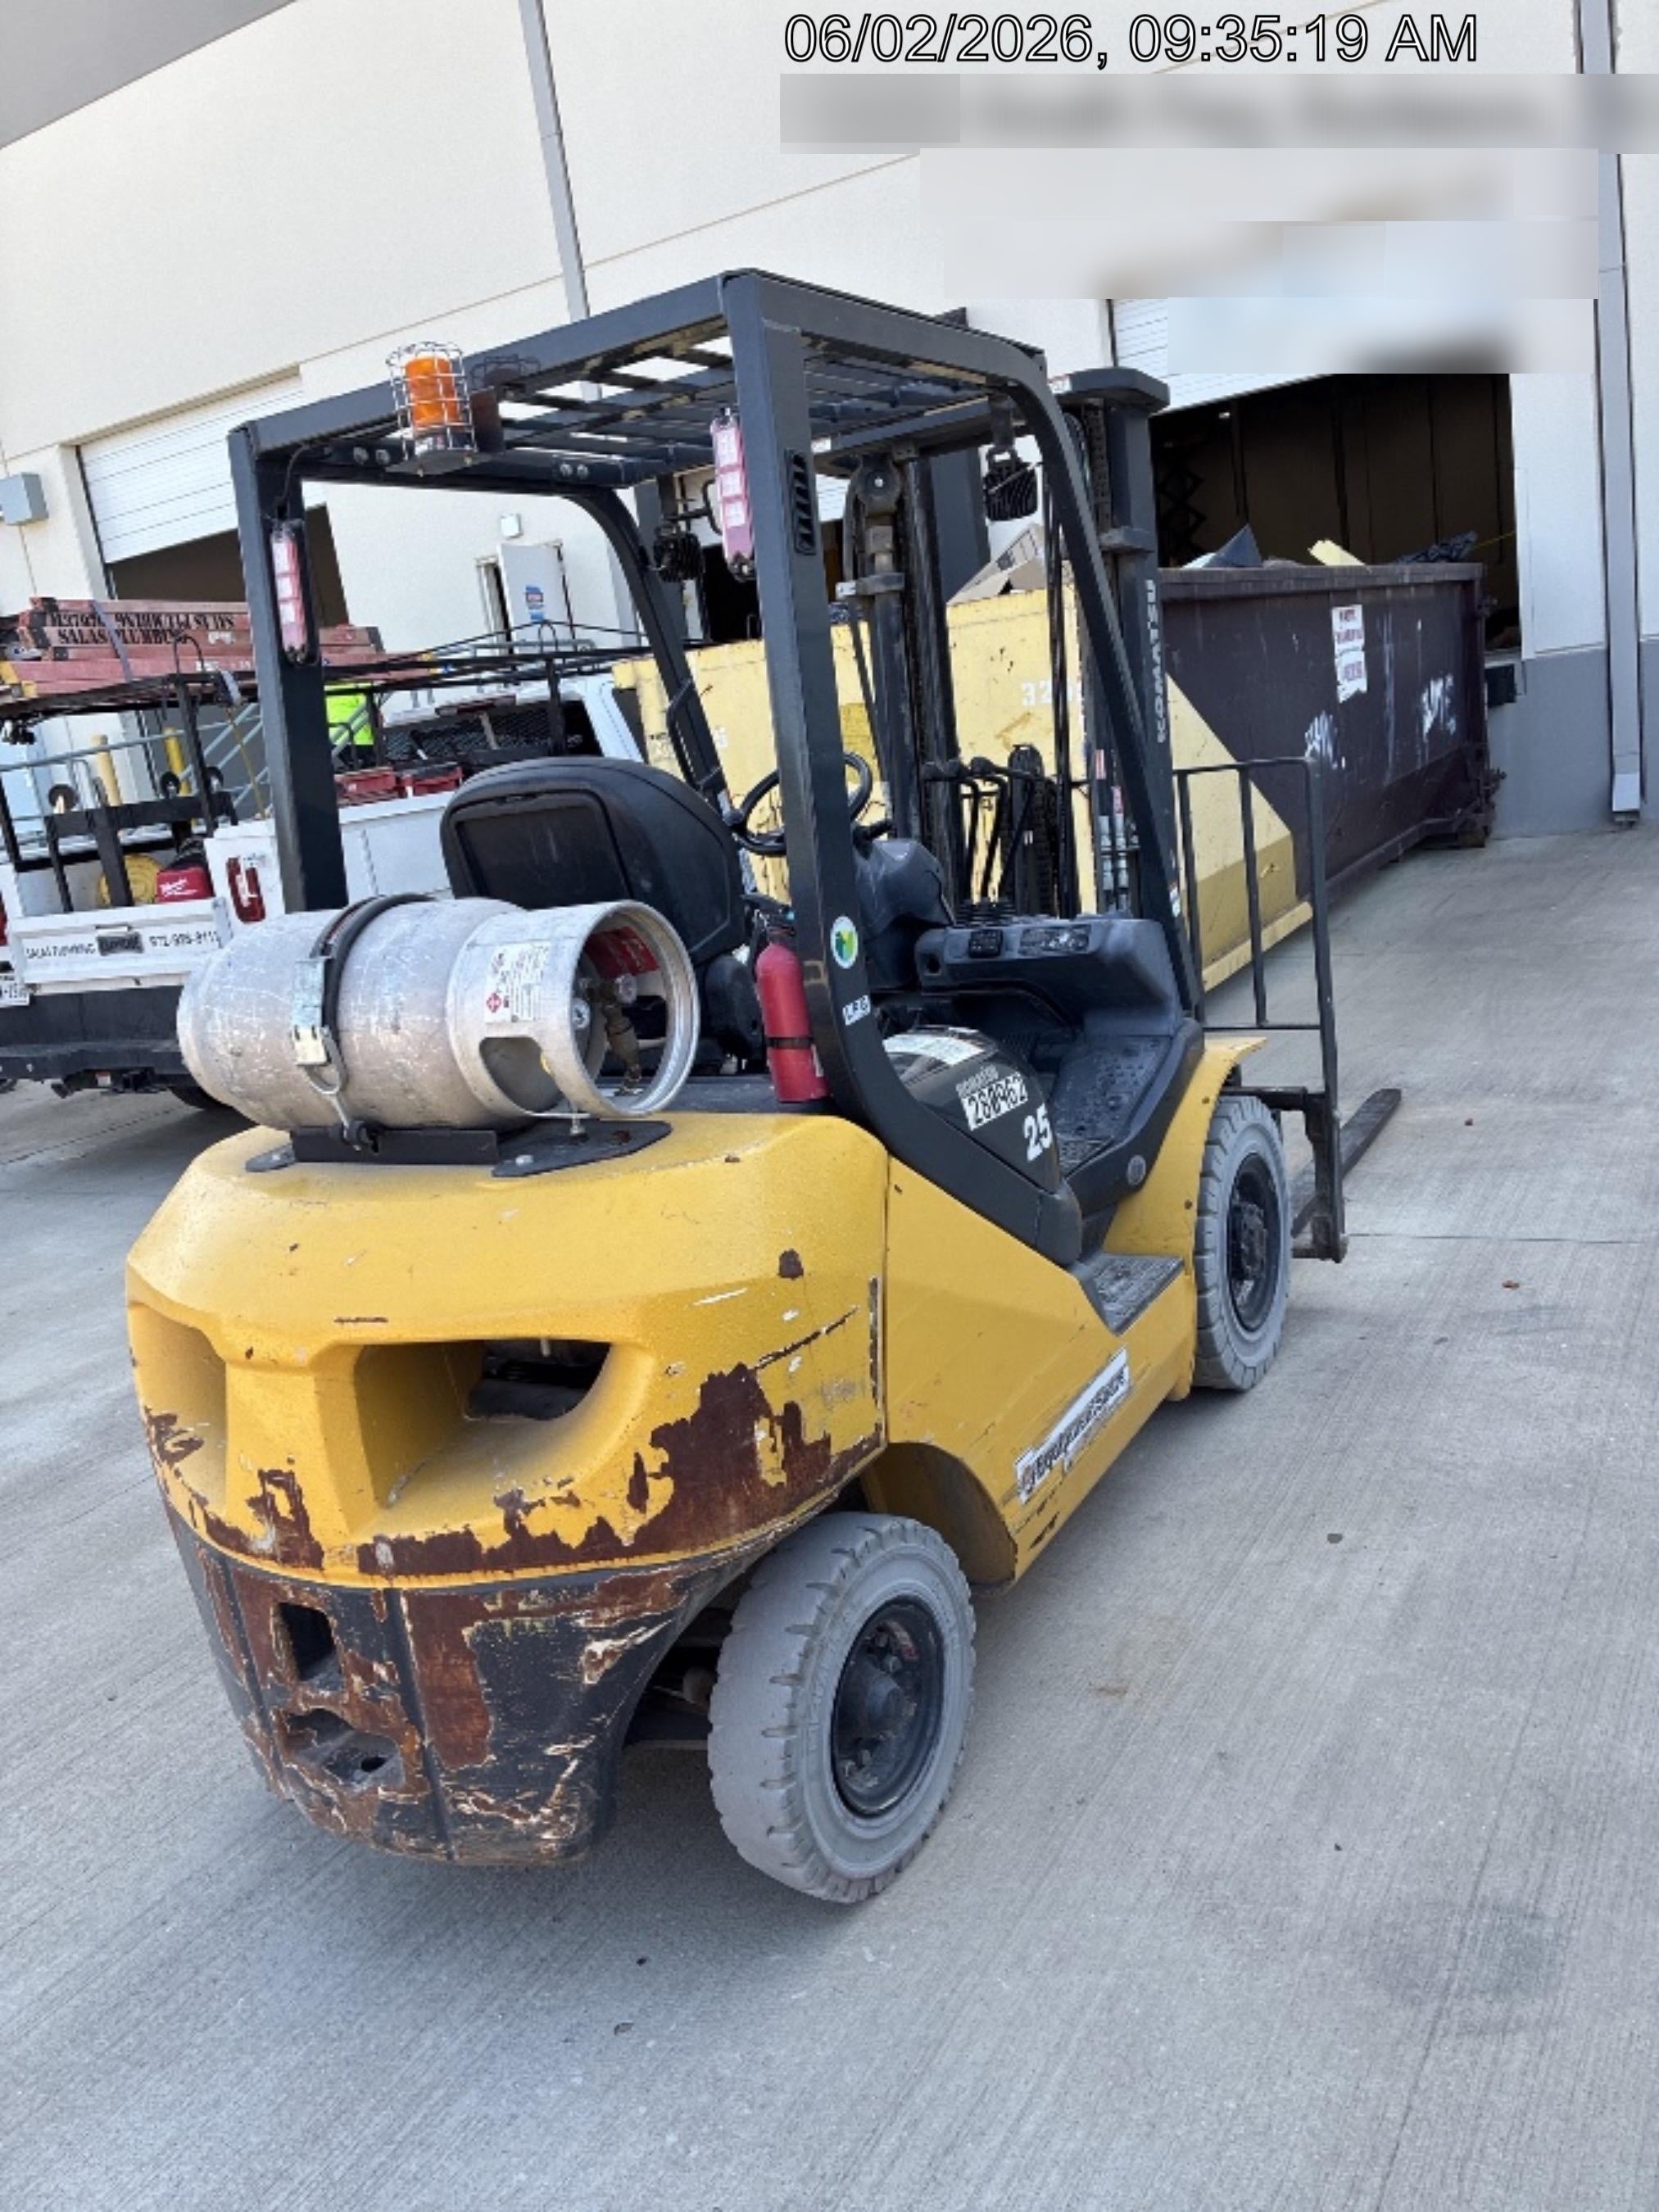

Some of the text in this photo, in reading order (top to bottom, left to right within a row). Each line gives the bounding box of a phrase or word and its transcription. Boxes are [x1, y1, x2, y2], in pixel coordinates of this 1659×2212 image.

[57, 628, 108, 645] SALAS
[1145, 578, 1167, 744] KOMATSU
[1023, 1102, 1054, 1162] 25
